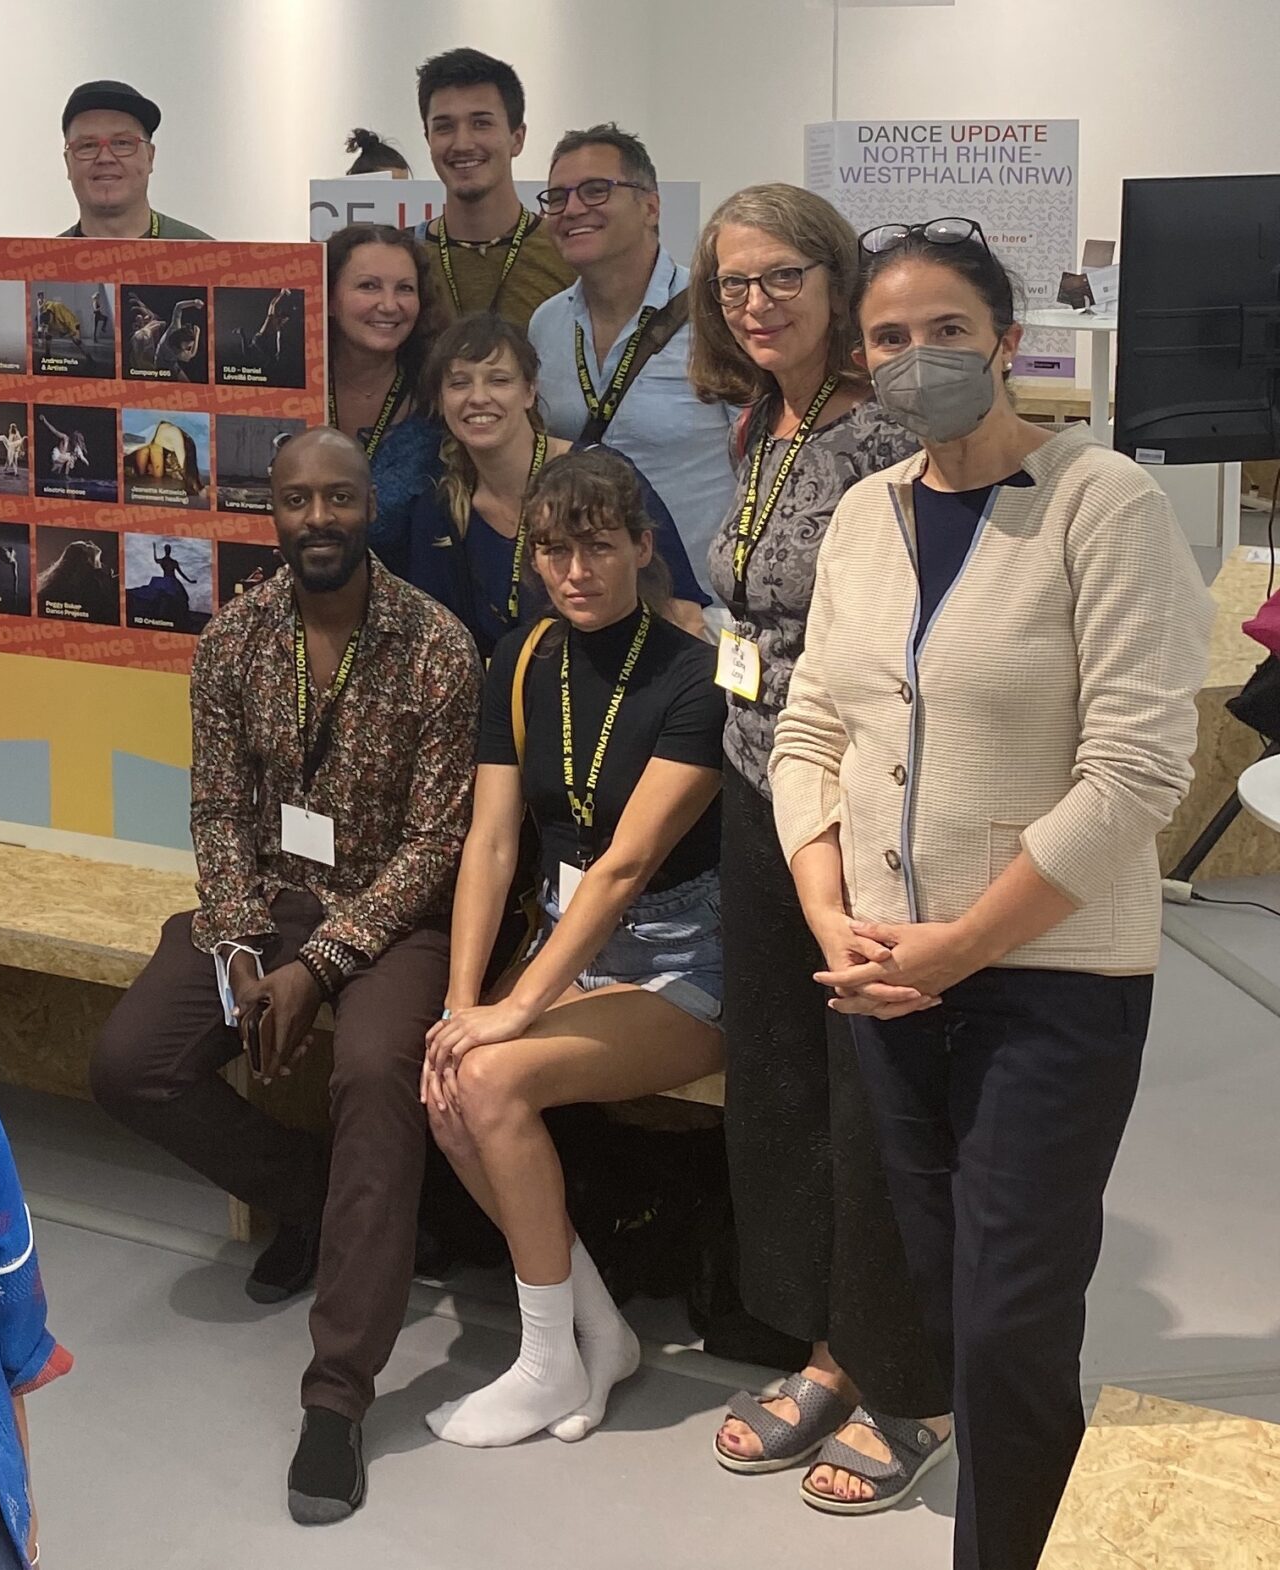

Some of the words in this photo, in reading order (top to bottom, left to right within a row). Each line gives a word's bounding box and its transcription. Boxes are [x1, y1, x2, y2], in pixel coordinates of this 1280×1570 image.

[858, 125, 943, 143] DANCE
[950, 124, 1048, 143] UPDATE
[863, 146, 948, 164] NORTH
[955, 146, 1042, 164] RHINE-
[839, 166, 994, 184] WESTPHALIA
[999, 165, 1072, 186] (NRW)
[751, 433, 804, 542] INTERNATIONALE
[739, 506, 752, 536] NRW
[561, 682, 572, 755] TANZMESSE
[586, 685, 626, 790] INTERNATIONALE
[619, 618, 651, 683] TANZMESSE
[564, 757, 574, 786] NRW
